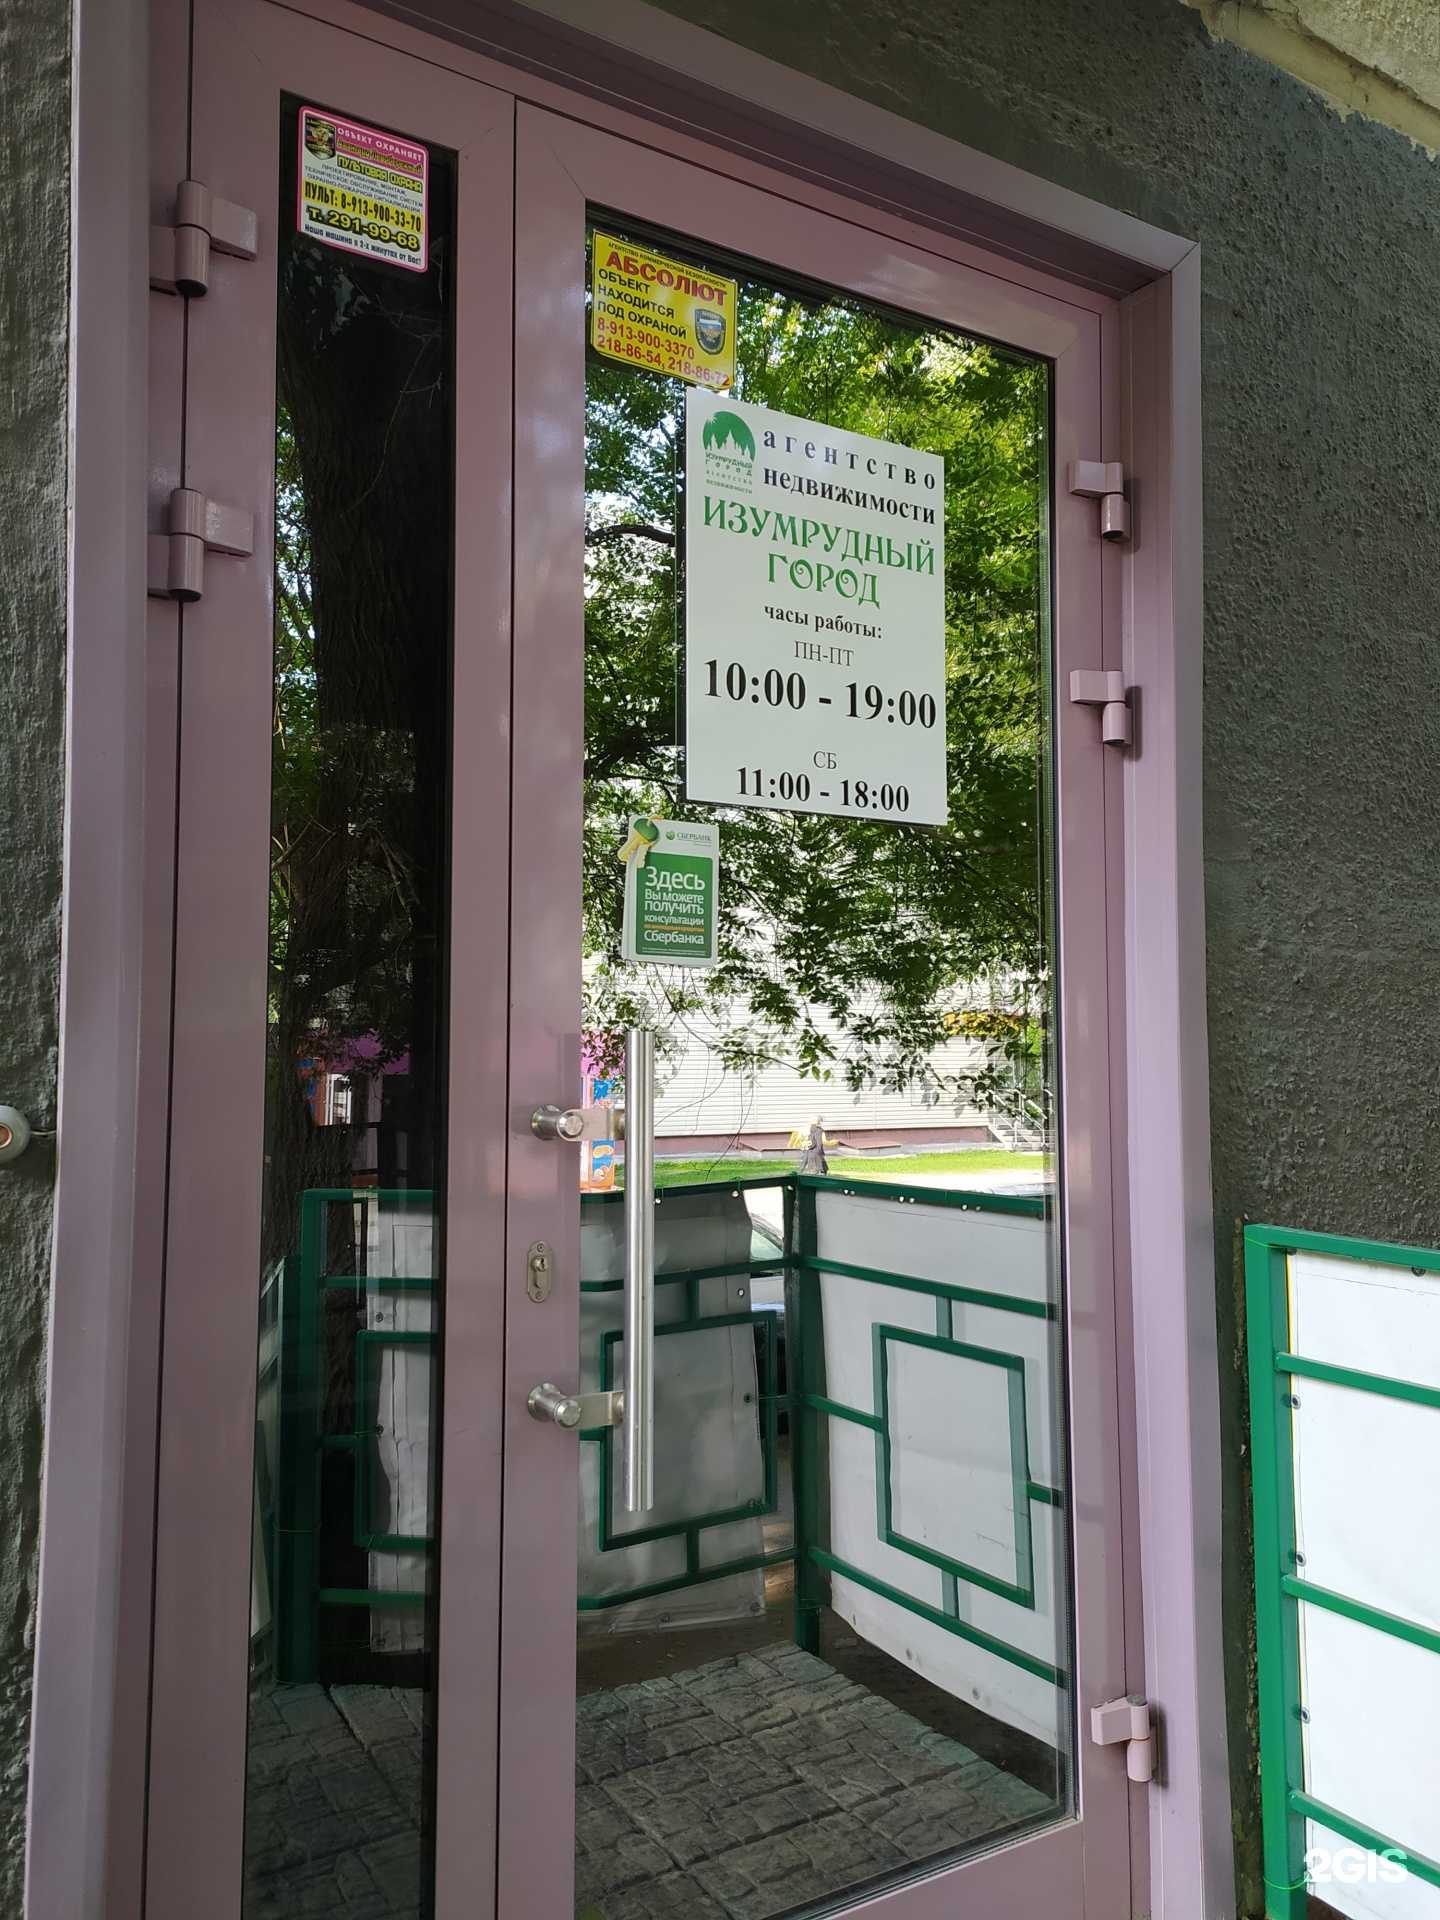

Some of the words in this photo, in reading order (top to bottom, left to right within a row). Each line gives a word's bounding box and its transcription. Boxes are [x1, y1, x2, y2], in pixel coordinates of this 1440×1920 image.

[337, 127, 372, 145] ОБЪЕКТ
[375, 141, 422, 162] ОХРАНЯЕТ
[338, 155, 387, 181] ПУЛЬТОВАЯ
[390, 172, 422, 193] ОХРАНА
[305, 181, 338, 207] ПУЛЬТ:
[341, 193, 421, 232] 8-913-900-33-70
[328, 209, 420, 252] 291-99-68
[598, 268, 650, 294] ОБЪЕКТ
[606, 251, 727, 306] АБСОЛЮТ
[597, 301, 625, 321] ПОД
[628, 310, 687, 340] ОХРАНОЙ
[598, 284, 675, 320] НАХОДИТСЯ
[597, 317, 695, 360] 8-913-900-3370
[596, 335, 665, 370] 218-86-54,
[668, 356, 730, 386] 218-86-72
[763, 430, 936, 490] агентство
[763, 467, 936, 525] недвижимости
[703, 495, 935, 576] ИЗУМРУДНЫЙ
[768, 552, 880, 609] ГОРОД
[764, 605, 809, 626] часы
[814, 614, 883, 639] работы:
[794, 640, 855, 667] ПН-ПТ
[704, 659, 806, 710] 10:00
[845, 682, 937, 729] 19:00
[813, 750, 838, 770] СБ
[736, 767, 811, 802] 11:00
[840, 779, 910, 813] 18:00
[644, 889, 662, 900] Вы
[662, 891, 705, 905] можете
[645, 866, 706, 891] Здесь
[644, 901, 705, 915] получить
[644, 914, 705, 926] консультации
[643, 929, 705, 946] Сбербанка
